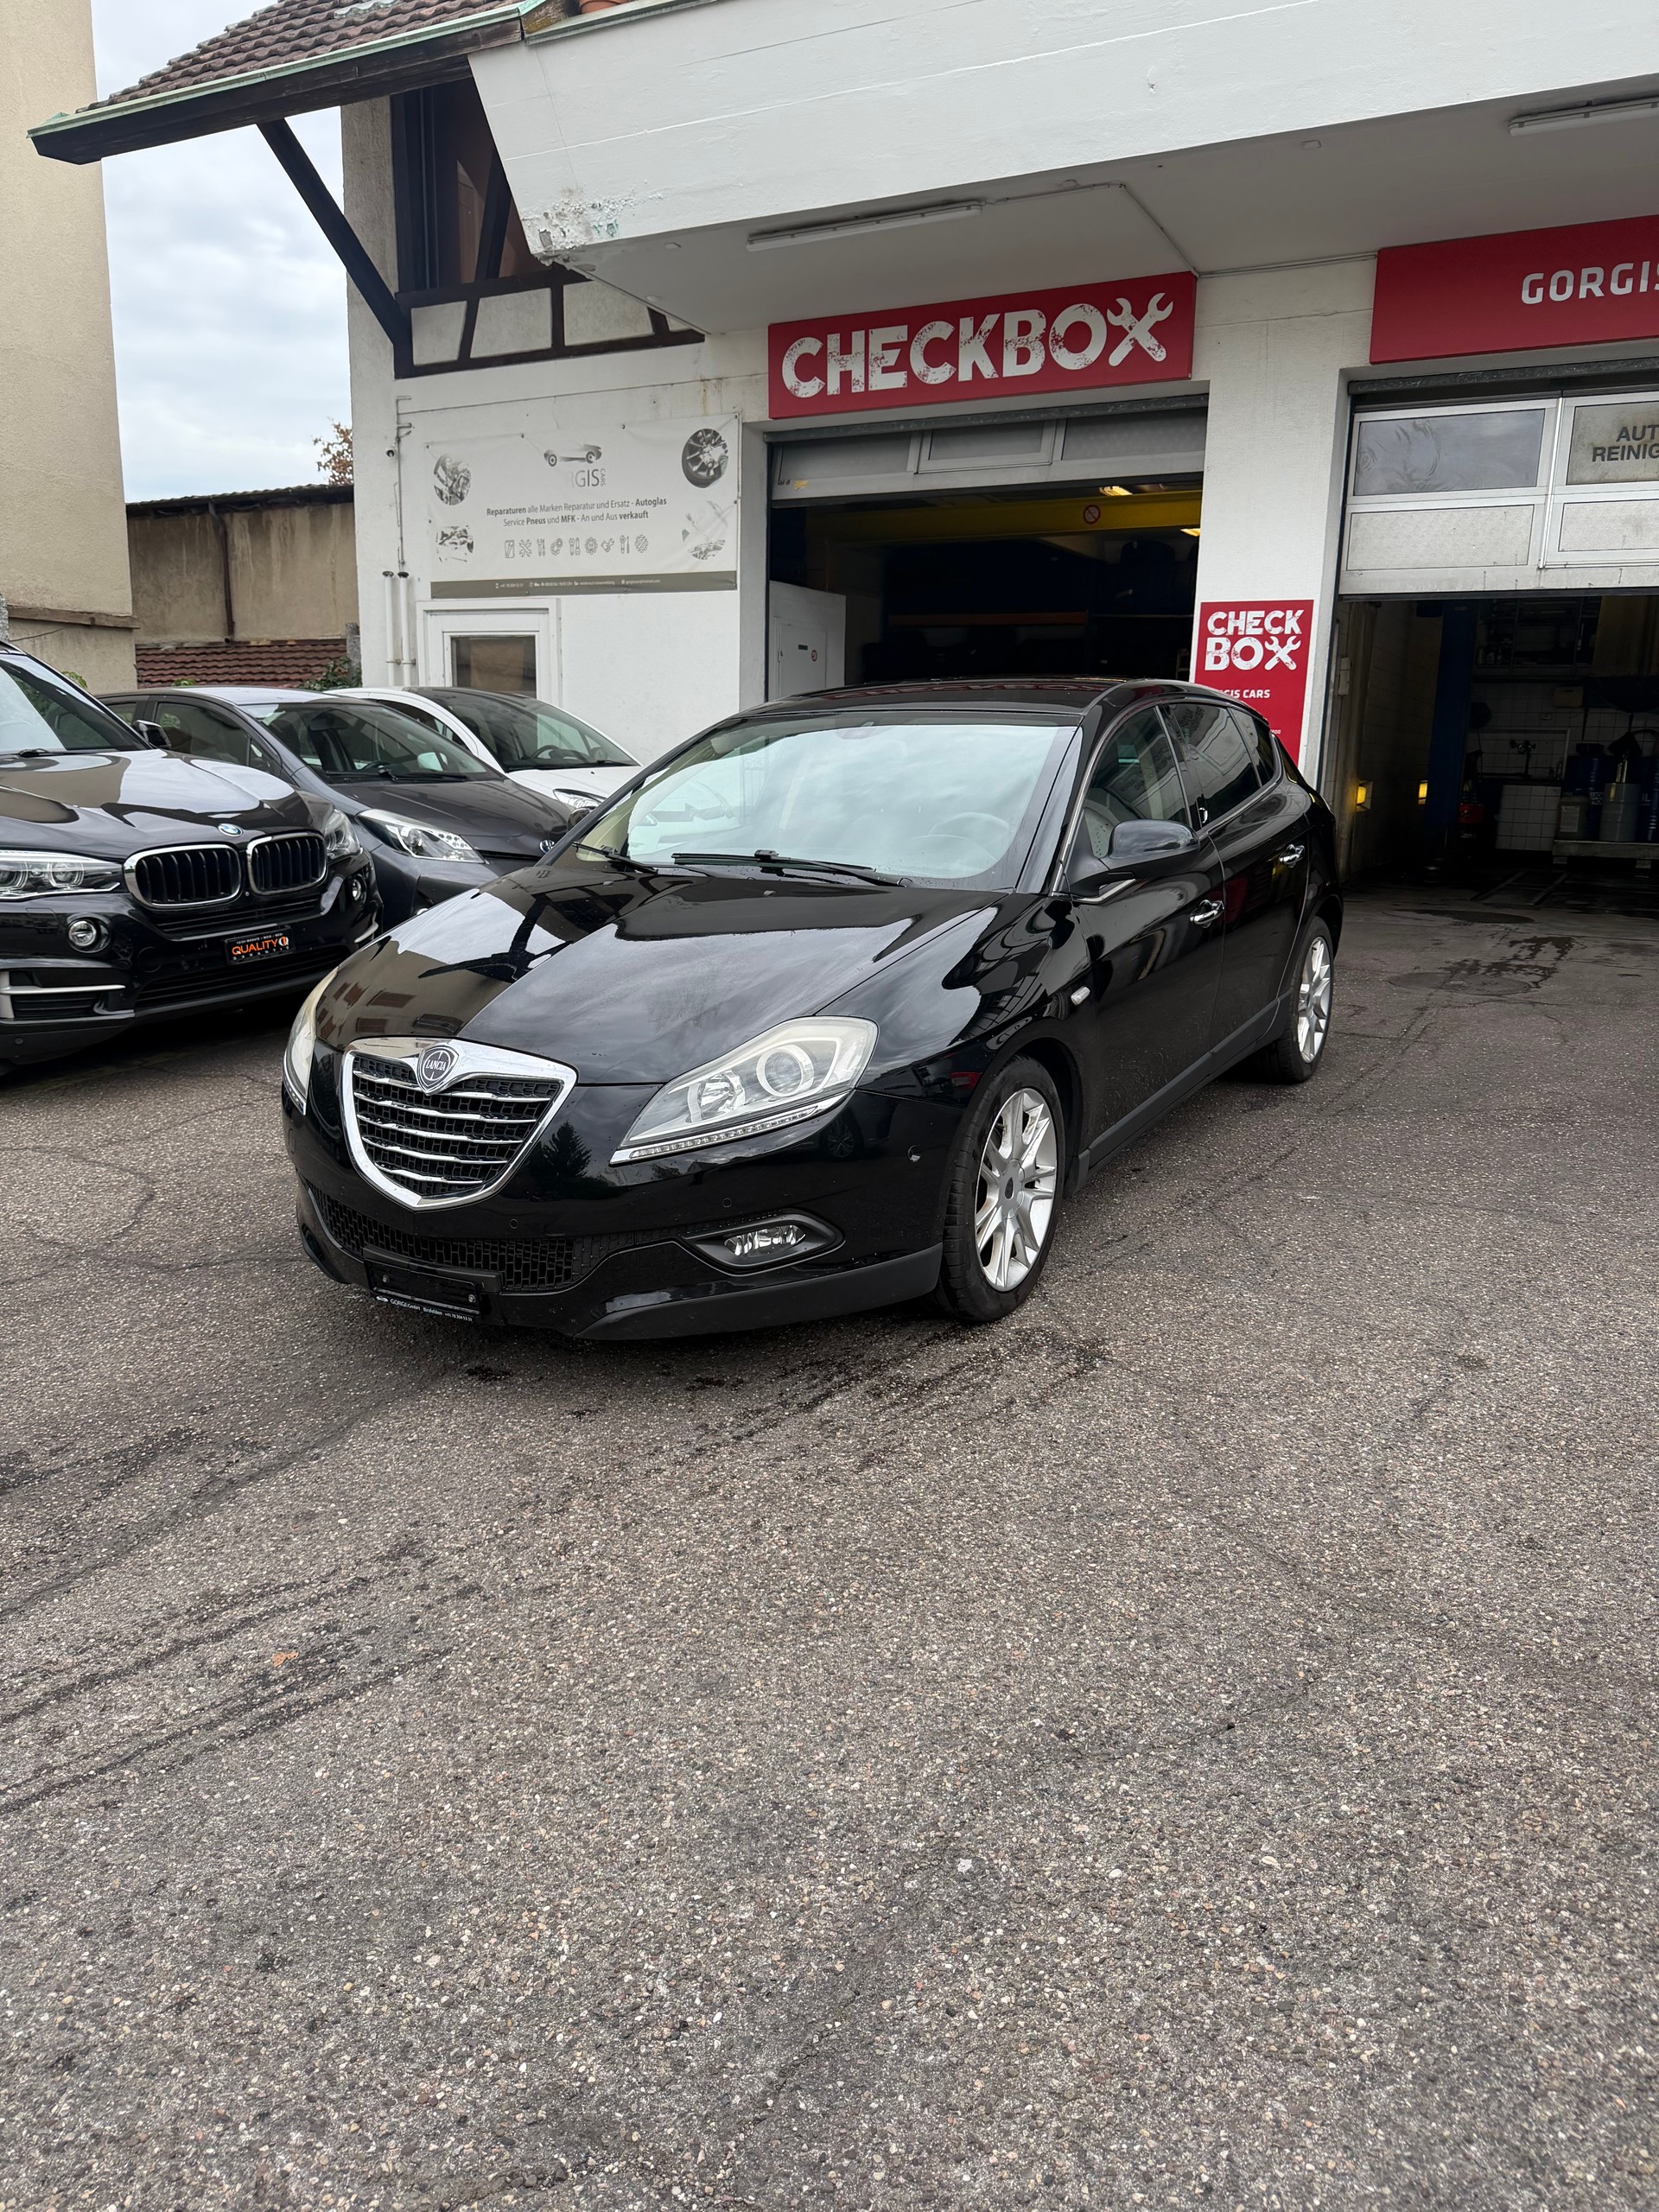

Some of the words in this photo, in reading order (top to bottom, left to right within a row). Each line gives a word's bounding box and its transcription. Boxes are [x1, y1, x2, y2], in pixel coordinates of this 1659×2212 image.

[1521, 261, 1659, 305] GORGI
[781, 292, 1174, 398] CHECKBOX
[486, 506, 527, 516] Reparaturen
[527, 505, 539, 513] alle
[539, 504, 563, 513] Marken
[563, 502, 595, 512] Reparatur
[596, 501, 610, 510] und
[611, 499, 630, 508] Ersatz
[635, 497, 667, 508] Autoglas
[503, 518, 525, 527] Service
[526, 517, 546, 525] Pneus
[547, 516, 560, 524] und
[561, 515, 575, 524] MFK
[591, 512, 604, 522] und
[606, 512, 618, 521] Aus
[619, 510, 649, 520] verkauft
[1207, 609, 1305, 636] CHECK
[1205, 636, 1301, 671] BOX
[1243, 690, 1271, 699] CARS
[232, 938, 278, 956] QUALITY
[425, 1059, 447, 1071] LANCIA
